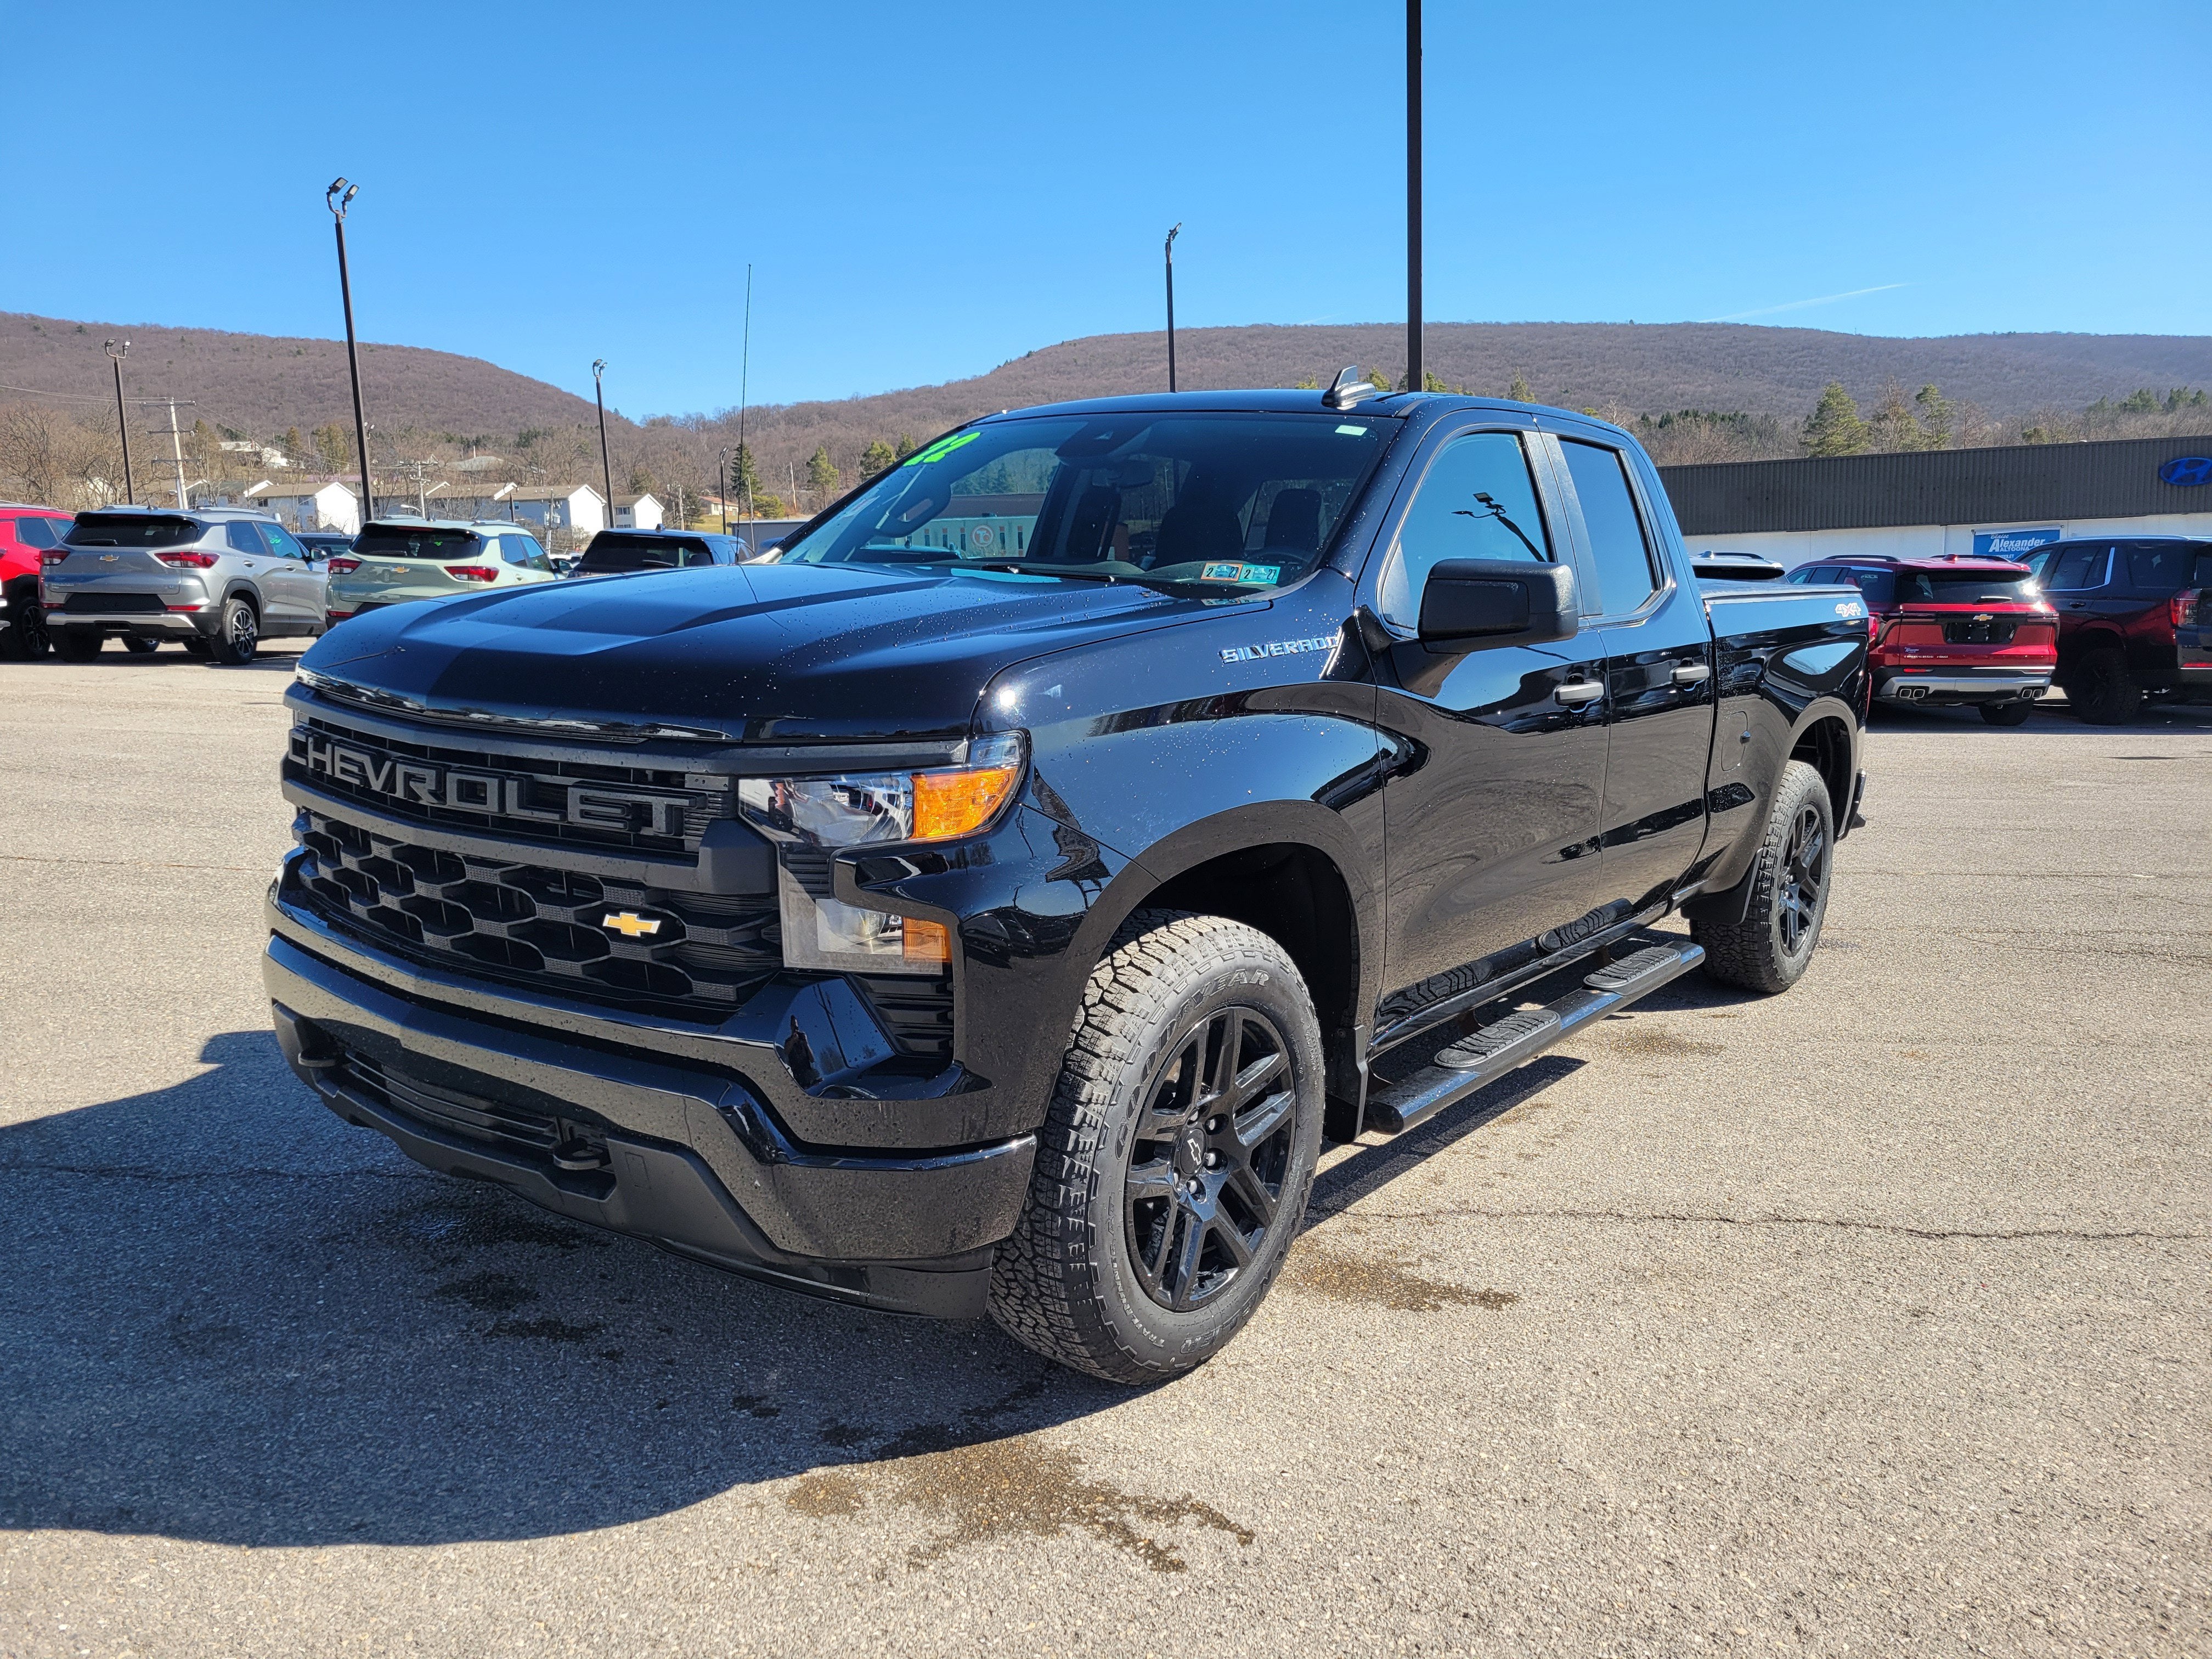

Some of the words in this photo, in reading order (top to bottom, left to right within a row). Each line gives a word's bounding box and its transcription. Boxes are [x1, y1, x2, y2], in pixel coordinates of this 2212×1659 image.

[1988, 538, 2045, 552] Alexander
[1206, 567, 1214, 577] 2
[1228, 567, 1239, 578] 27
[1244, 569, 1251, 579] 2
[1266, 569, 1277, 580] 27
[1220, 636, 1339, 664] SILVERADO
[288, 725, 708, 837] CHEVROLET
[1115, 969, 1269, 1160] GOODYEAR
